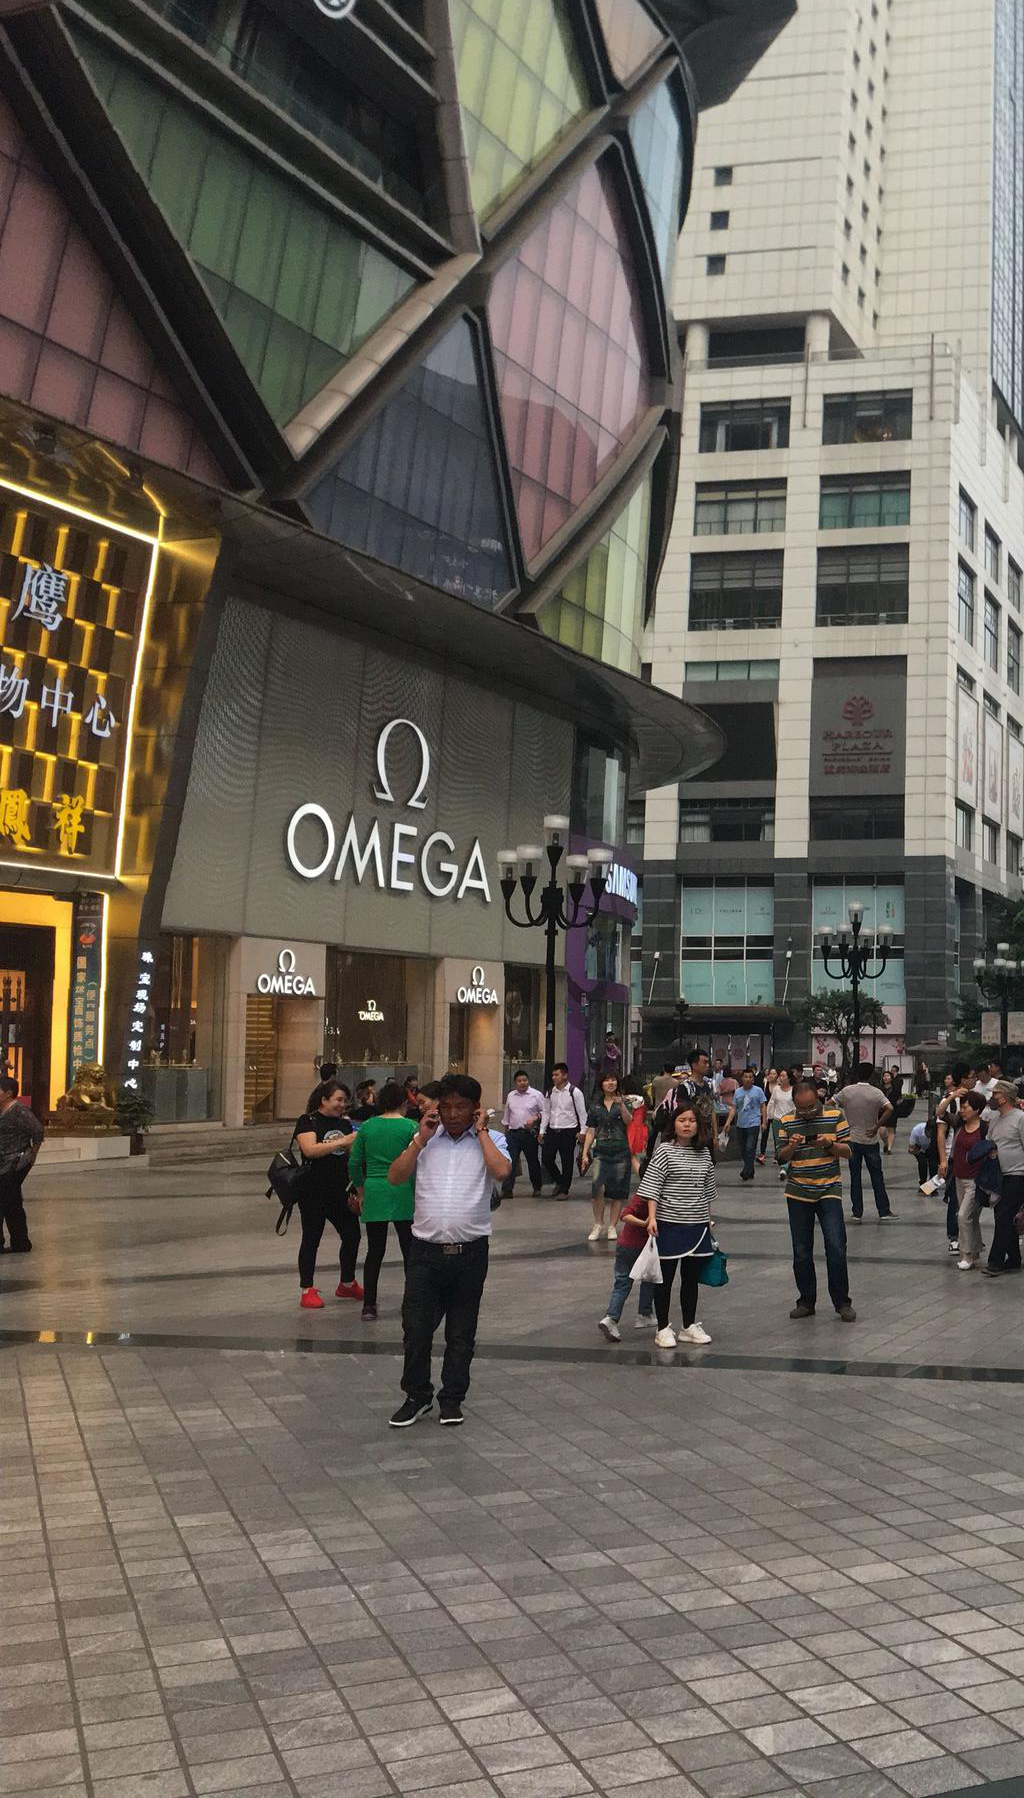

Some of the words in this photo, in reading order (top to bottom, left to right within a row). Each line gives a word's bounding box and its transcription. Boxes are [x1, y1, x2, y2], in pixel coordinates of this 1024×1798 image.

[11, 562, 68, 631] 鹰
[286, 802, 492, 903] OMEGA
[257, 973, 316, 995] OMEGA
[457, 986, 498, 1004] OMEGA
[358, 1010, 384, 1021] OMEGA
